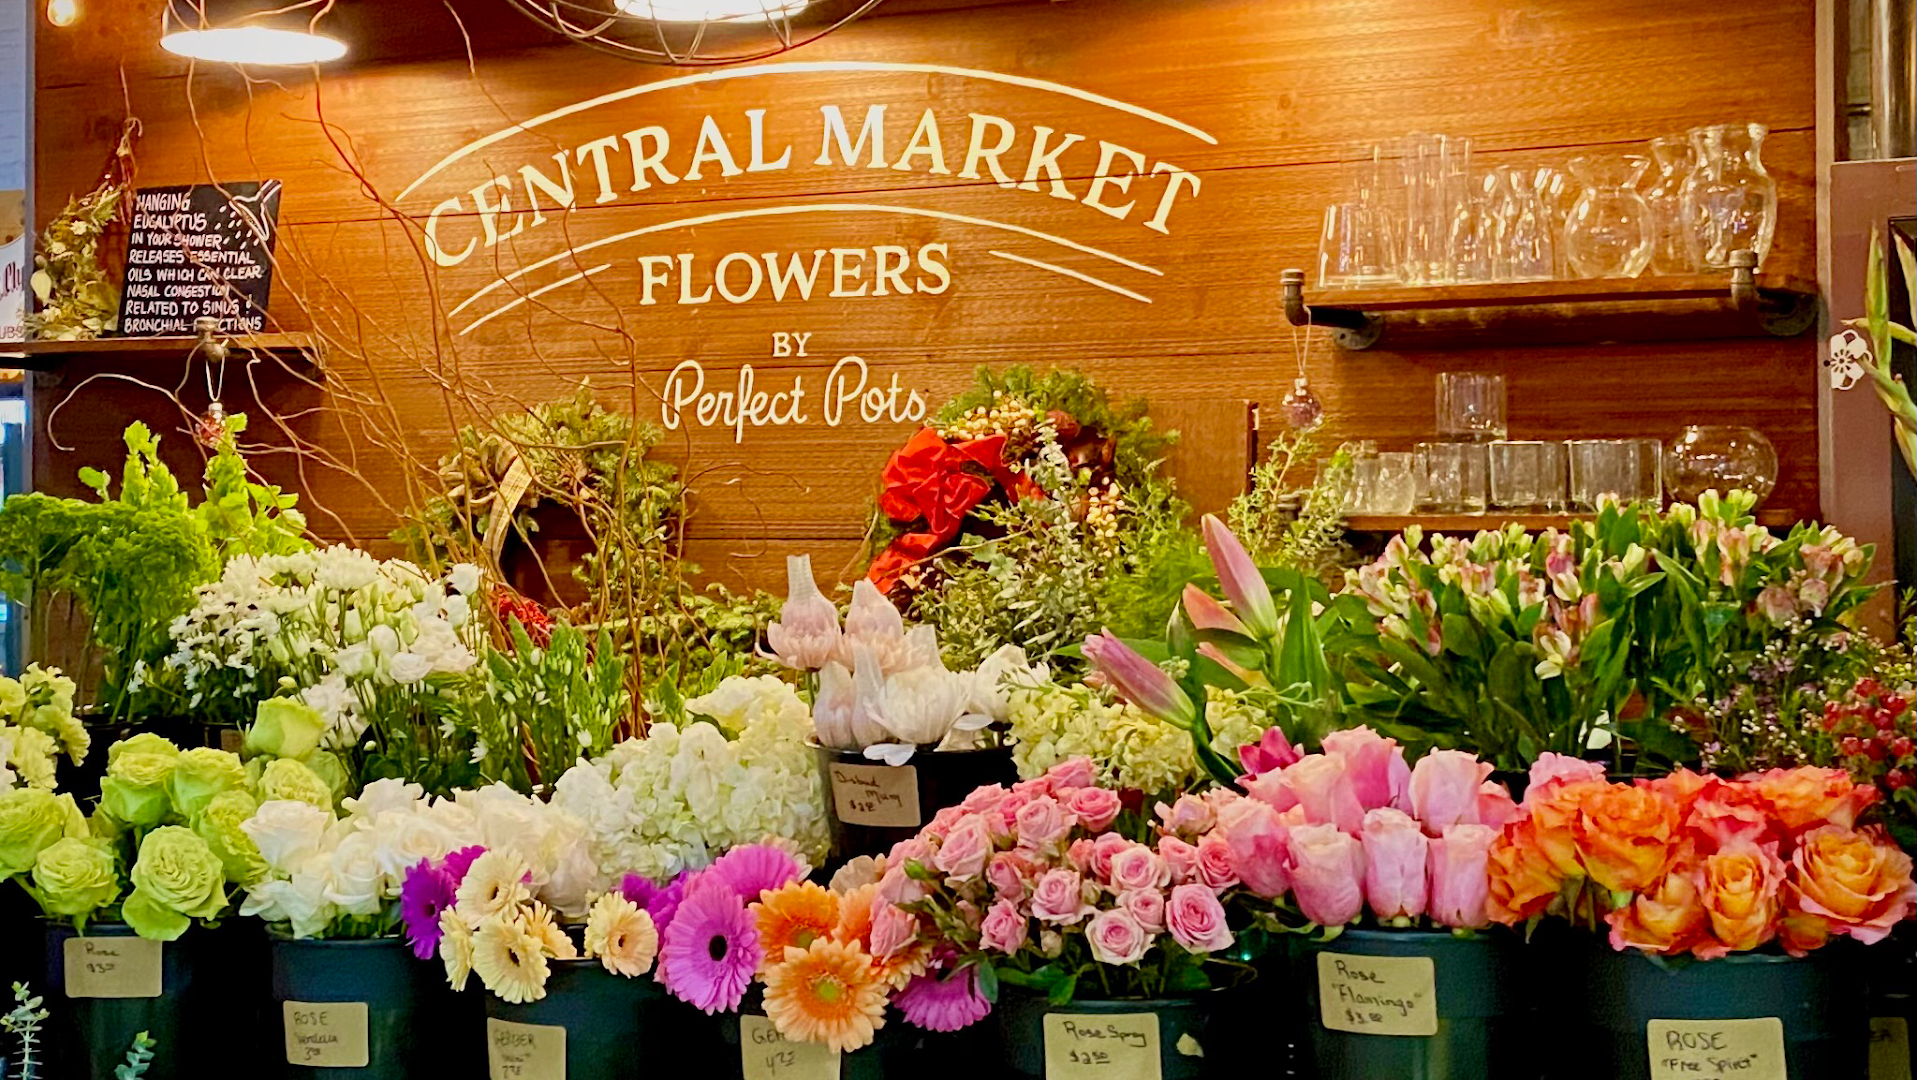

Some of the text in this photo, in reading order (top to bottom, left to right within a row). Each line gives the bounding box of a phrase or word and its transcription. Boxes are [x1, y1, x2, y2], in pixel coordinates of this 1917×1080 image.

[424, 104, 1201, 267] CENTRAL MARKET
[135, 192, 191, 212] HANGING
[133, 213, 207, 232] EUCALYPTUS
[131, 231, 223, 250] IN YOUR SHOWER
[129, 249, 255, 265] RELEASES ESSENTIAL
[128, 267, 152, 282] OILS
[156, 267, 194, 282] WHICH
[223, 264, 263, 280] CLEAR
[638, 242, 951, 305] FLOWERS
[126, 284, 160, 298] NASAL
[125, 300, 178, 316] RELATED
[181, 301, 199, 315] TO
[202, 299, 239, 315] SINUS
[123, 316, 188, 334] BRONCHIAL
[772, 332, 812, 357] BY
[661, 356, 926, 443] Perfect Pots
[1334, 959, 1385, 984] Rose
[294, 1011, 329, 1026] ROSE
[1063, 1021, 1147, 1048] Rose Spray
[1666, 1030, 1728, 1051] ROSE
